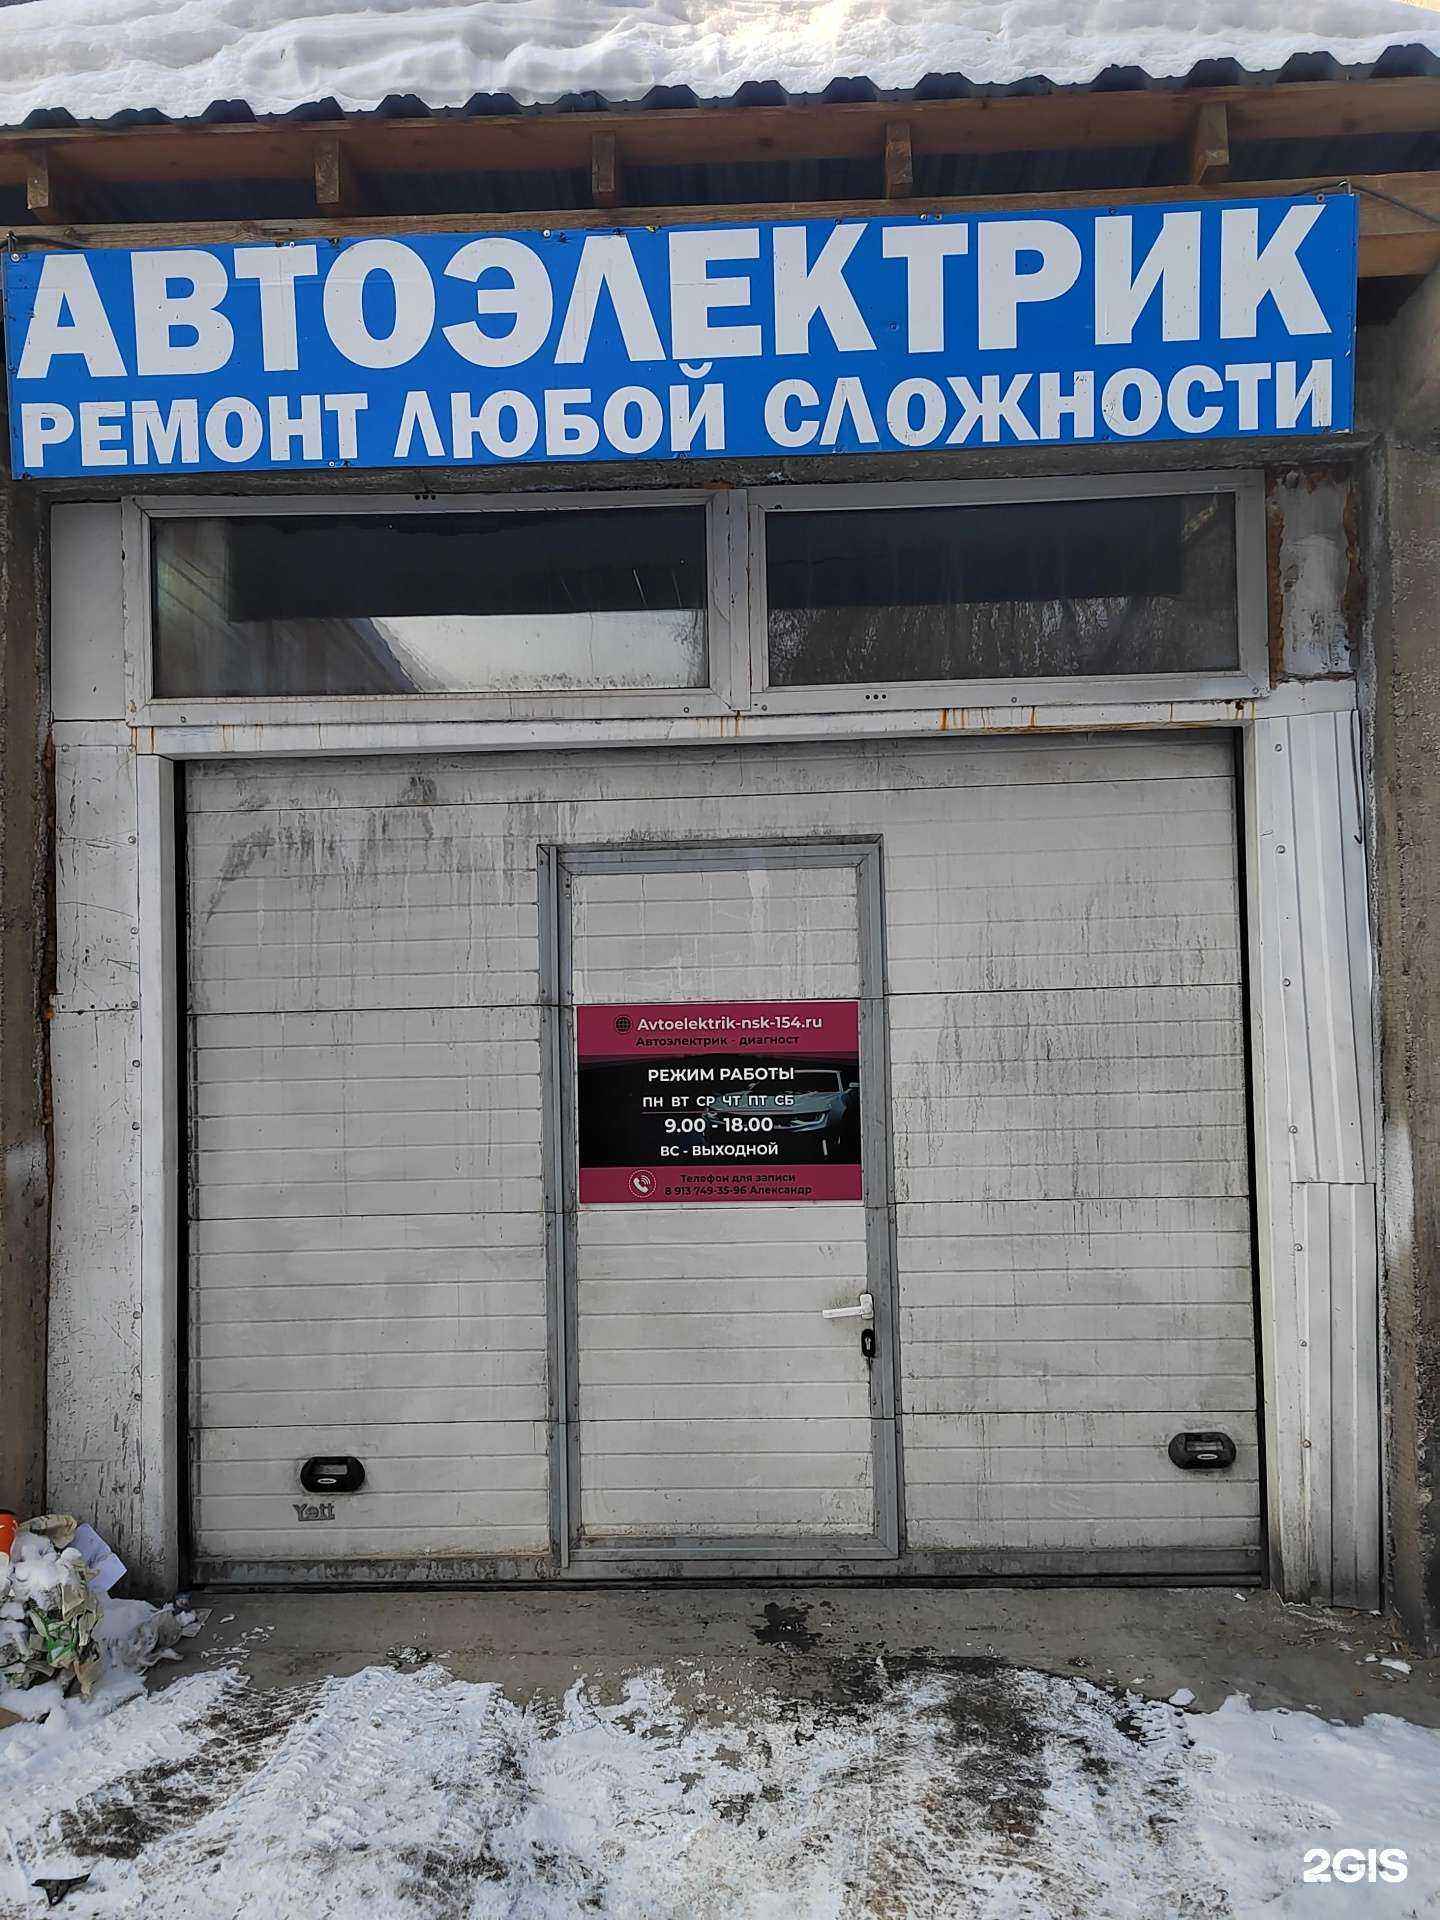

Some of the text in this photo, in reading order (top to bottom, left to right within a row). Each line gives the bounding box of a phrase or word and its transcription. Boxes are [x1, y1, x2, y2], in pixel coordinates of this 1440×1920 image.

[16, 203, 1332, 379] АВТОЭЛЕКТРИК
[20, 359, 1333, 468] РЕМОНТ ЛЮБОЙ СЛОЖНОСТИ
[637, 1016, 823, 1032] Avtoelektrik-nsk-154.ru
[635, 1036, 728, 1047] Автоэлектрик
[738, 1035, 800, 1046] диагност
[648, 1067, 795, 1082] РЕЖИМ РАБОТЫ
[643, 1095, 794, 1108] ПН ВТ СР ЧТ ПТ СБ
[664, 1118, 706, 1133] 9.00
[722, 1117, 774, 1133] 18.00
[660, 1146, 680, 1157] ВС
[692, 1142, 778, 1157] ВЫХОДНОЙ
[680, 1174, 796, 1184] Телефон для записи
[664, 1186, 672, 1196] 8
[750, 1186, 812, 1195] Александр
